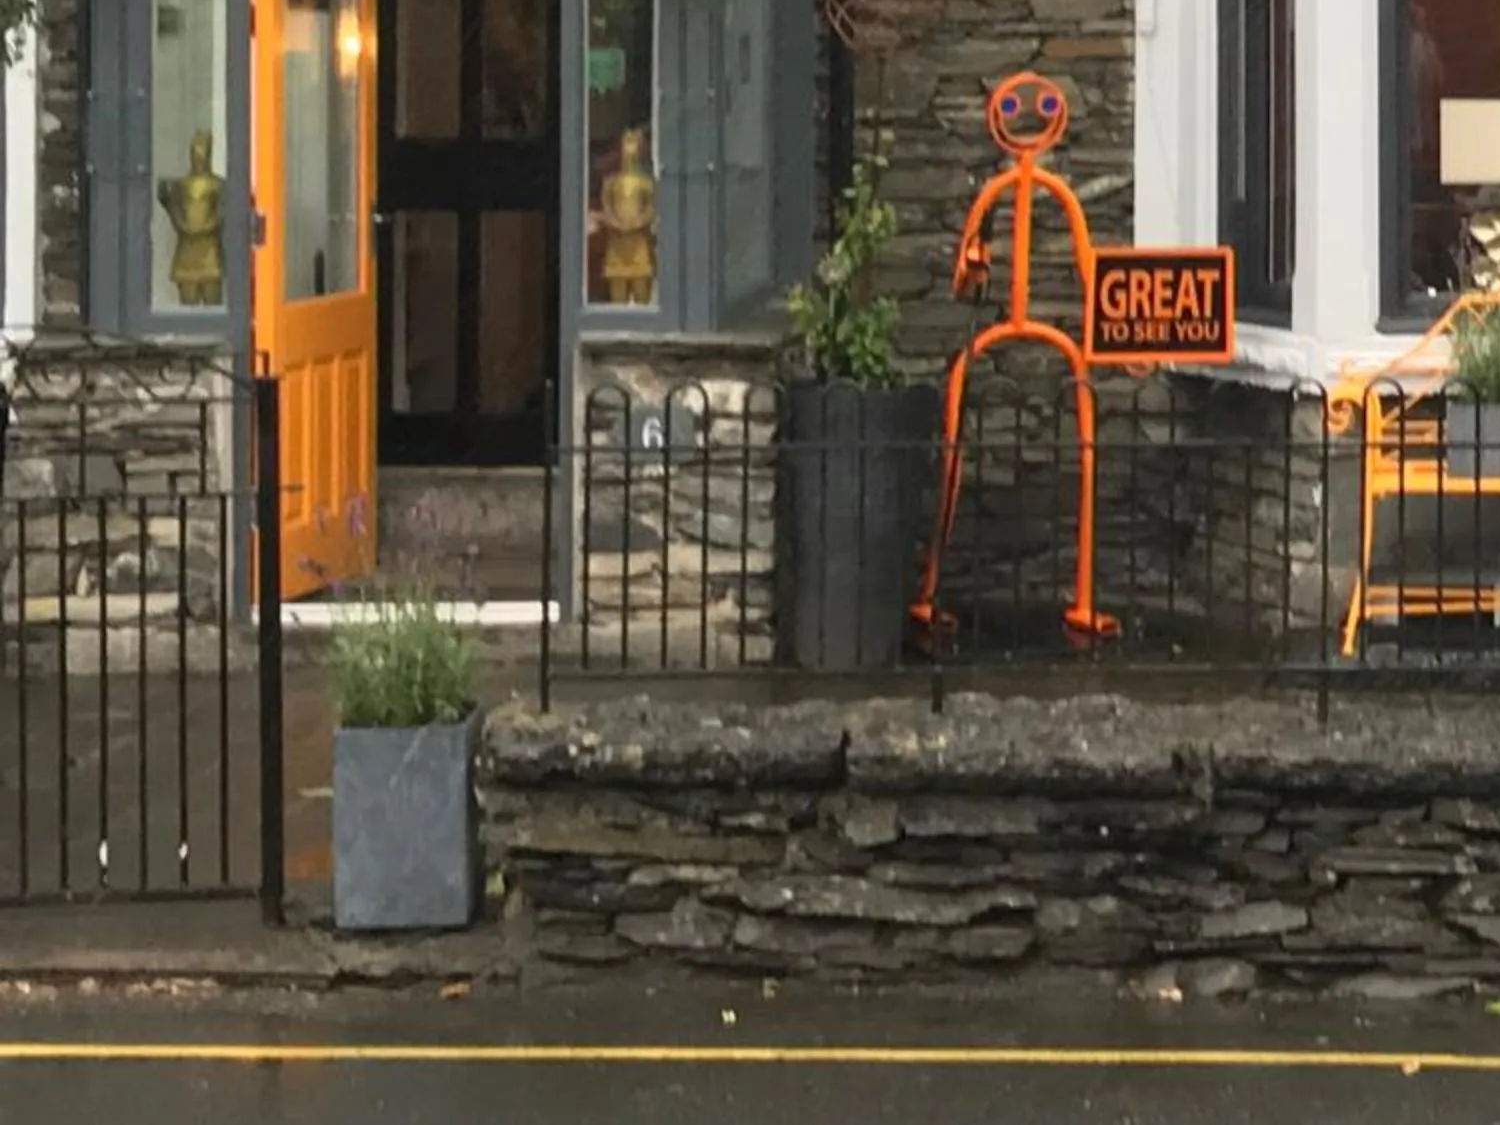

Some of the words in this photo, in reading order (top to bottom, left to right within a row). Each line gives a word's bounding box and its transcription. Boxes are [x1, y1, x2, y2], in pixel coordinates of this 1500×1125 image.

[1101, 269, 1220, 319] GREAT
[1101, 321, 1129, 342] TO
[1133, 321, 1170, 343] SEE
[1174, 321, 1220, 342] YOU
[641, 416, 664, 449] 6
